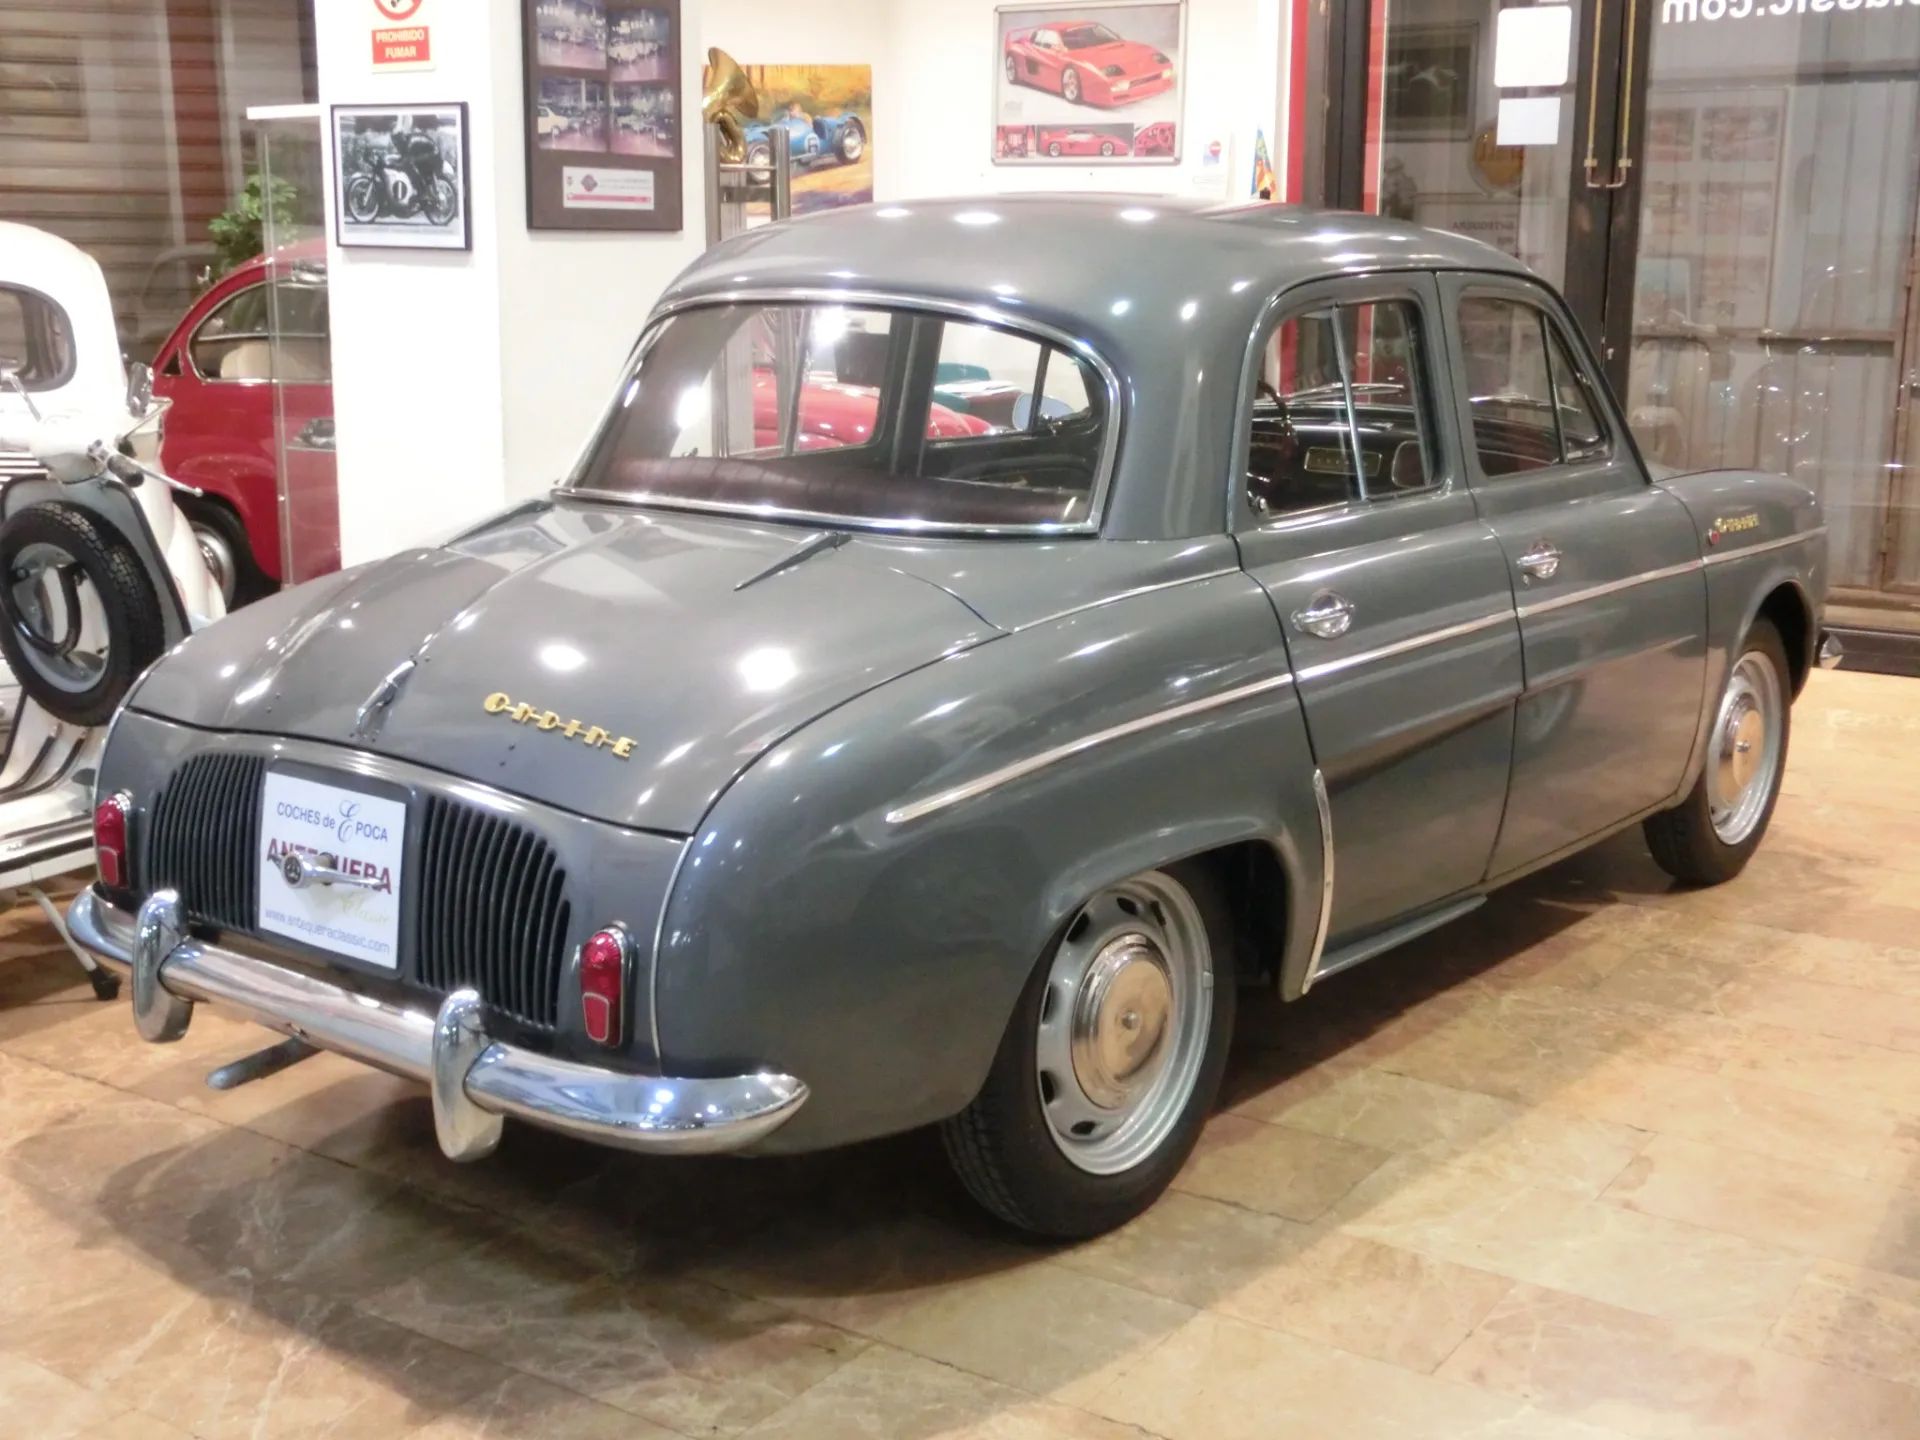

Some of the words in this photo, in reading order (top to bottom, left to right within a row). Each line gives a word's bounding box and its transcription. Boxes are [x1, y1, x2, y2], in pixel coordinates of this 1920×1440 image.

[376, 29, 425, 43] PROHIBIDO
[384, 46, 417, 59] FUMAR
[277, 802, 321, 825] COCHES
[322, 814, 336, 829] de
